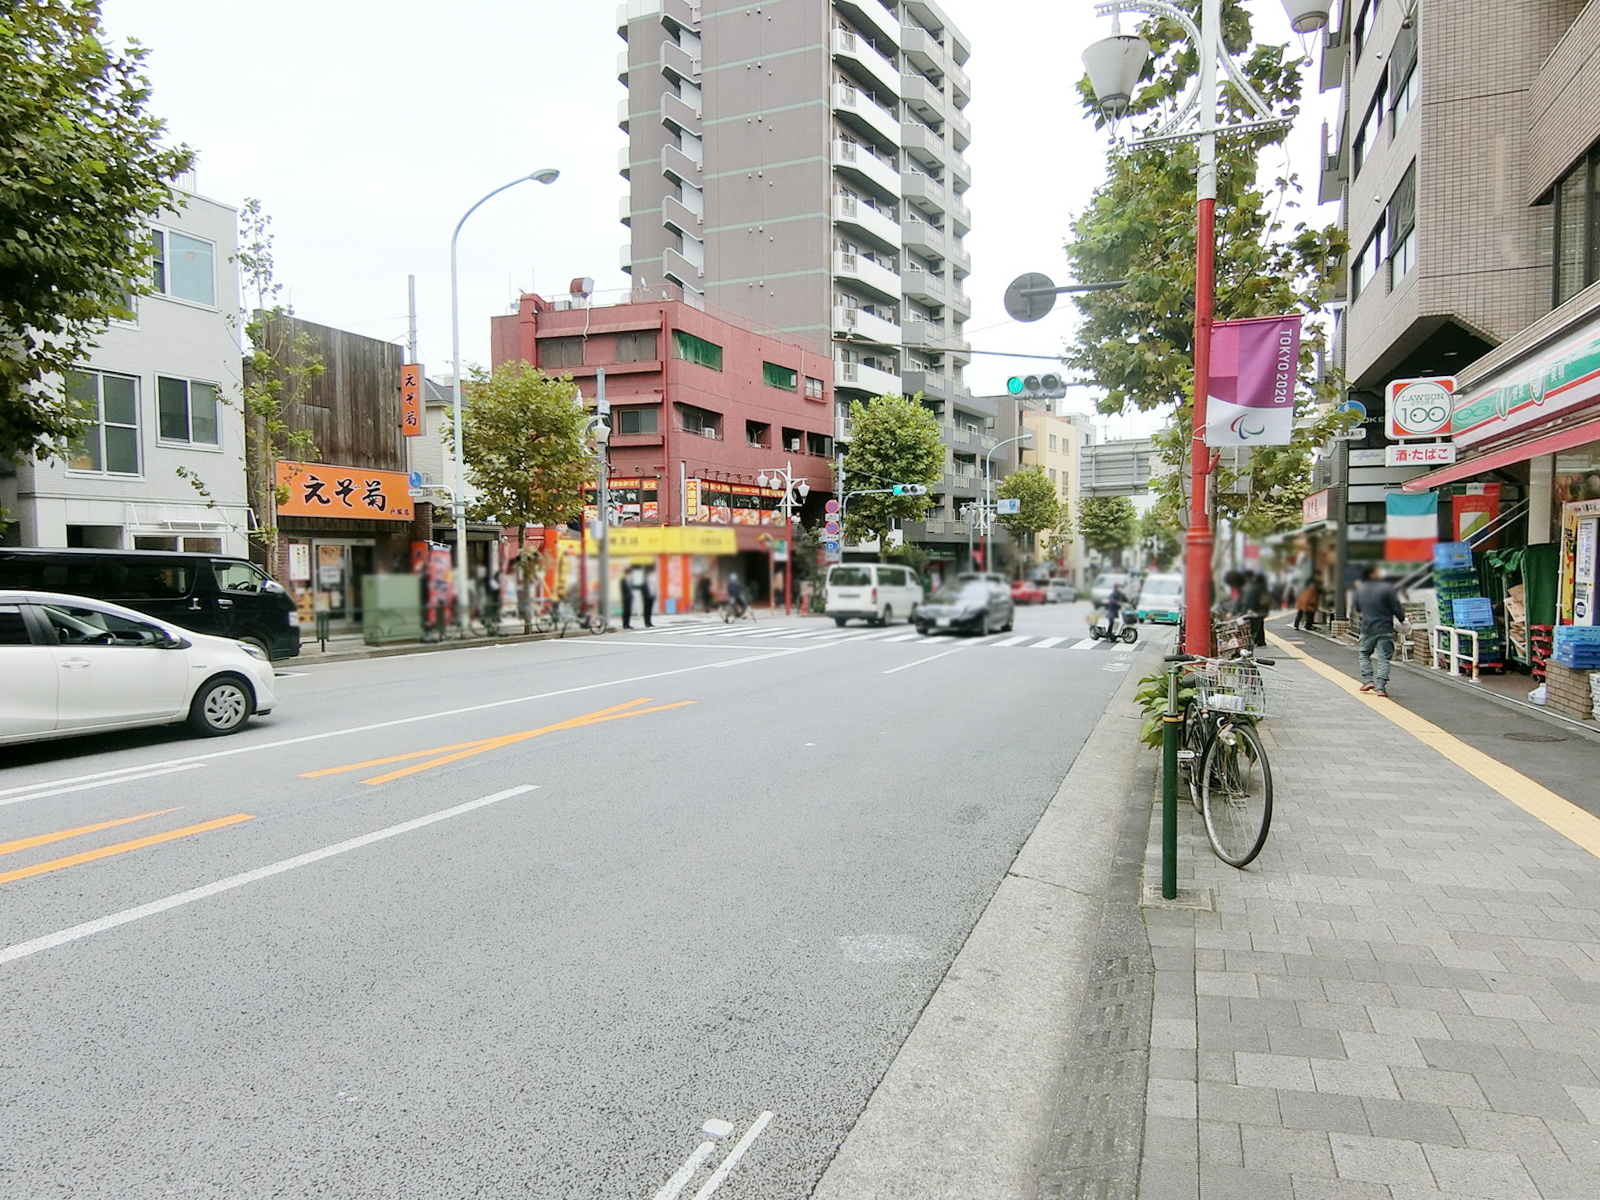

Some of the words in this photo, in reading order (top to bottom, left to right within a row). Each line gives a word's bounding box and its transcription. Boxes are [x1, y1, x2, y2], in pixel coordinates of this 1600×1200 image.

[1278, 329, 1293, 371] TOKYO
[1274, 373, 1288, 404] 2020
[1401, 393, 1445, 402] LAWSON
[1401, 406, 1446, 424] 100
